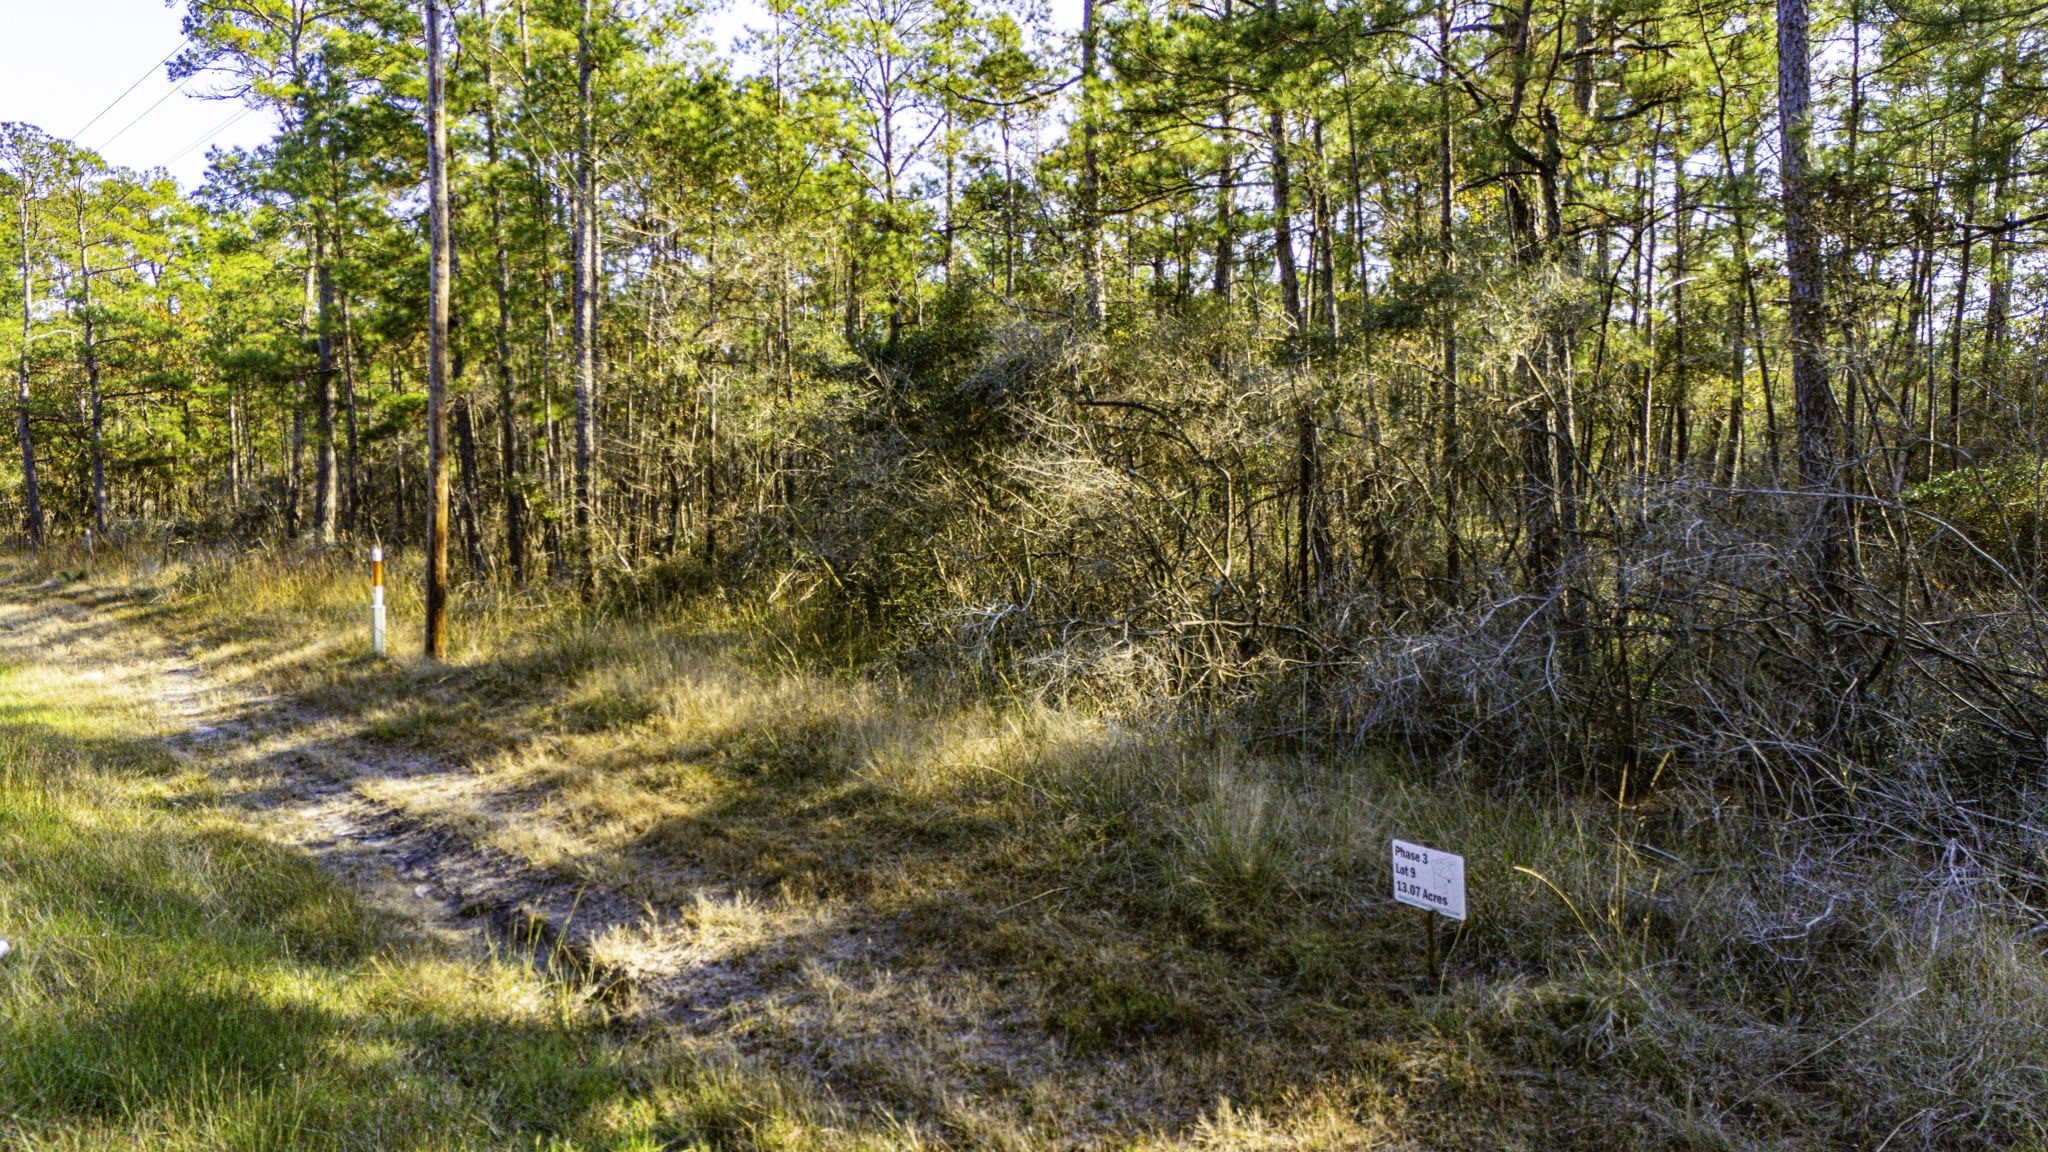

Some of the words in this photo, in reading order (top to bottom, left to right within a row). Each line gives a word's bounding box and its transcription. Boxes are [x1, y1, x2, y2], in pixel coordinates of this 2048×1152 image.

[1395, 845, 1420, 862] Phase
[1422, 853, 1428, 864] 3
[1395, 863, 1409, 876] Lot
[1410, 867, 1416, 878] 9
[1397, 881, 1421, 897] 13.07
[1422, 889, 1448, 906] Acres
